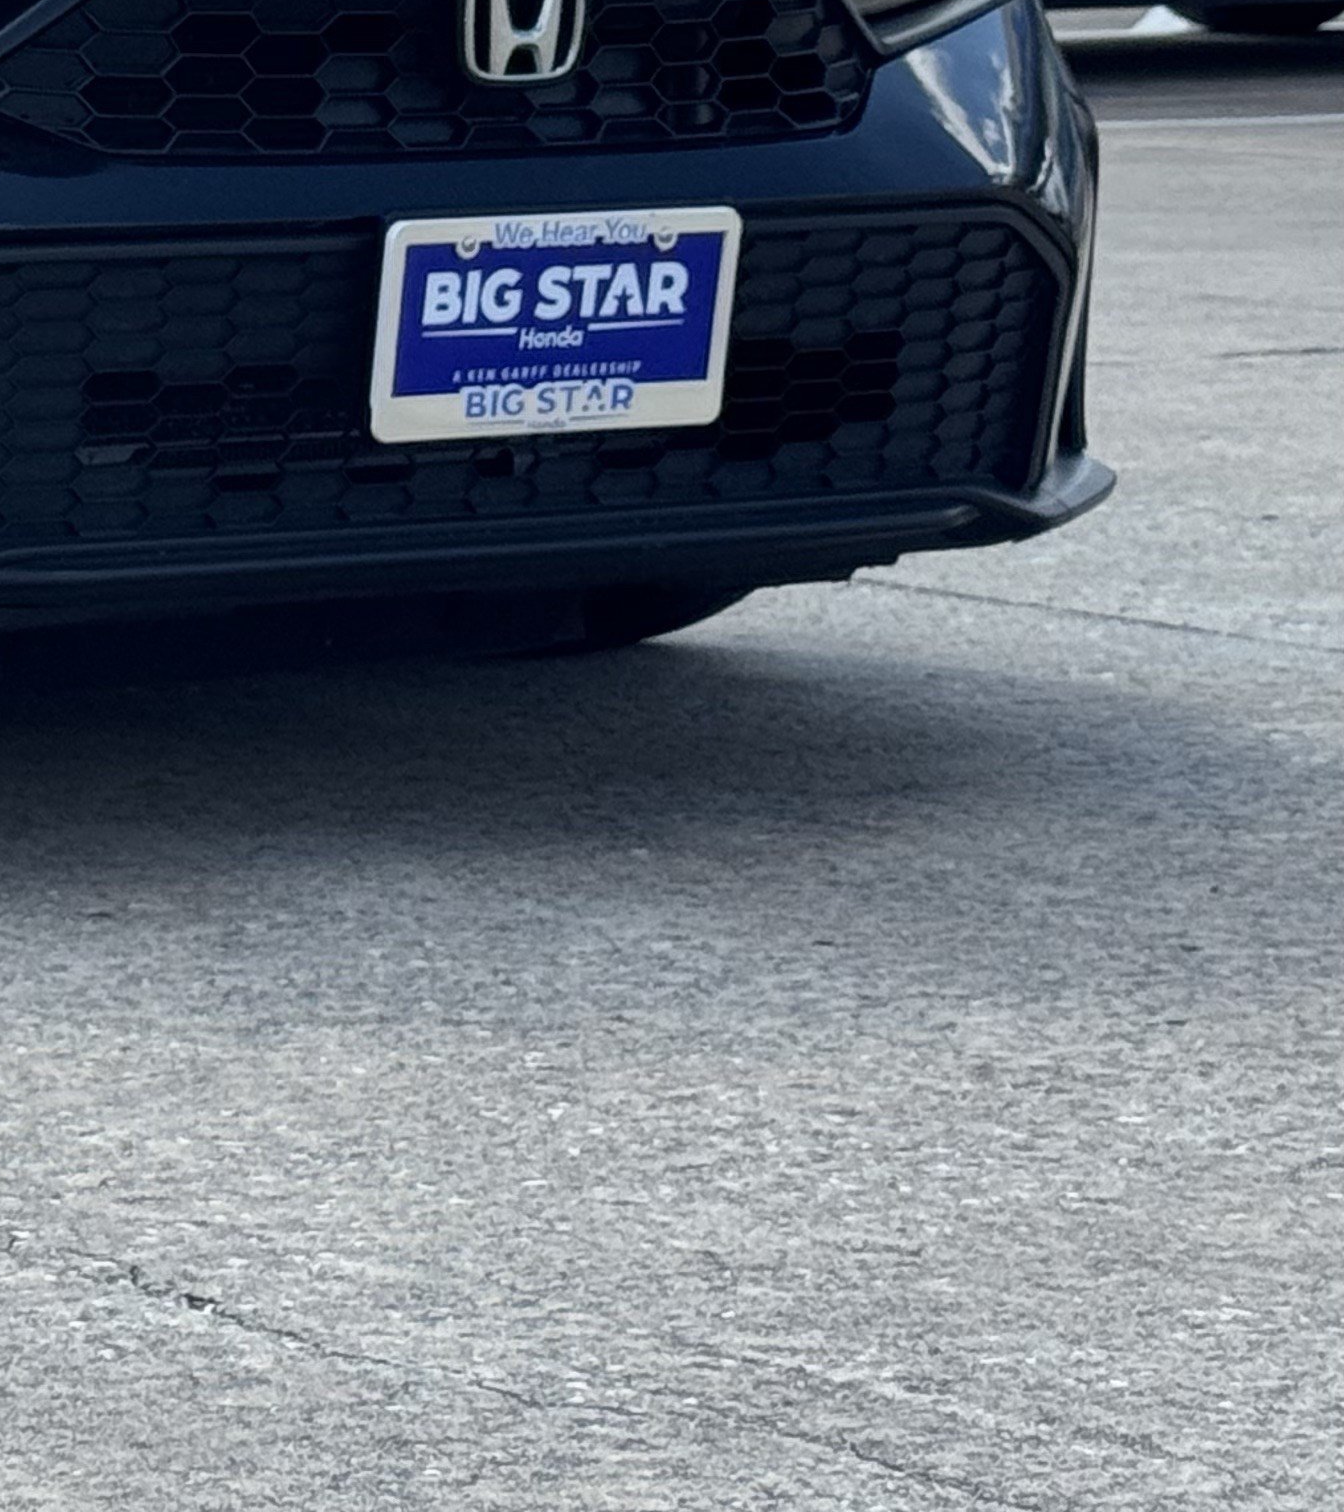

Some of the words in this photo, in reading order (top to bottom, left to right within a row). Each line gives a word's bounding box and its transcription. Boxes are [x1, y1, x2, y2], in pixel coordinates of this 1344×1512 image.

[495, 221, 534, 244] We
[542, 220, 599, 242] Hear
[605, 217, 648, 240] You
[422, 269, 524, 326] BIG
[534, 261, 689, 320] STAR
[518, 325, 585, 351] Honda
[553, 359, 642, 379] DEALERSHIP
[465, 389, 526, 419] BIG
[536, 384, 635, 415] STAR
